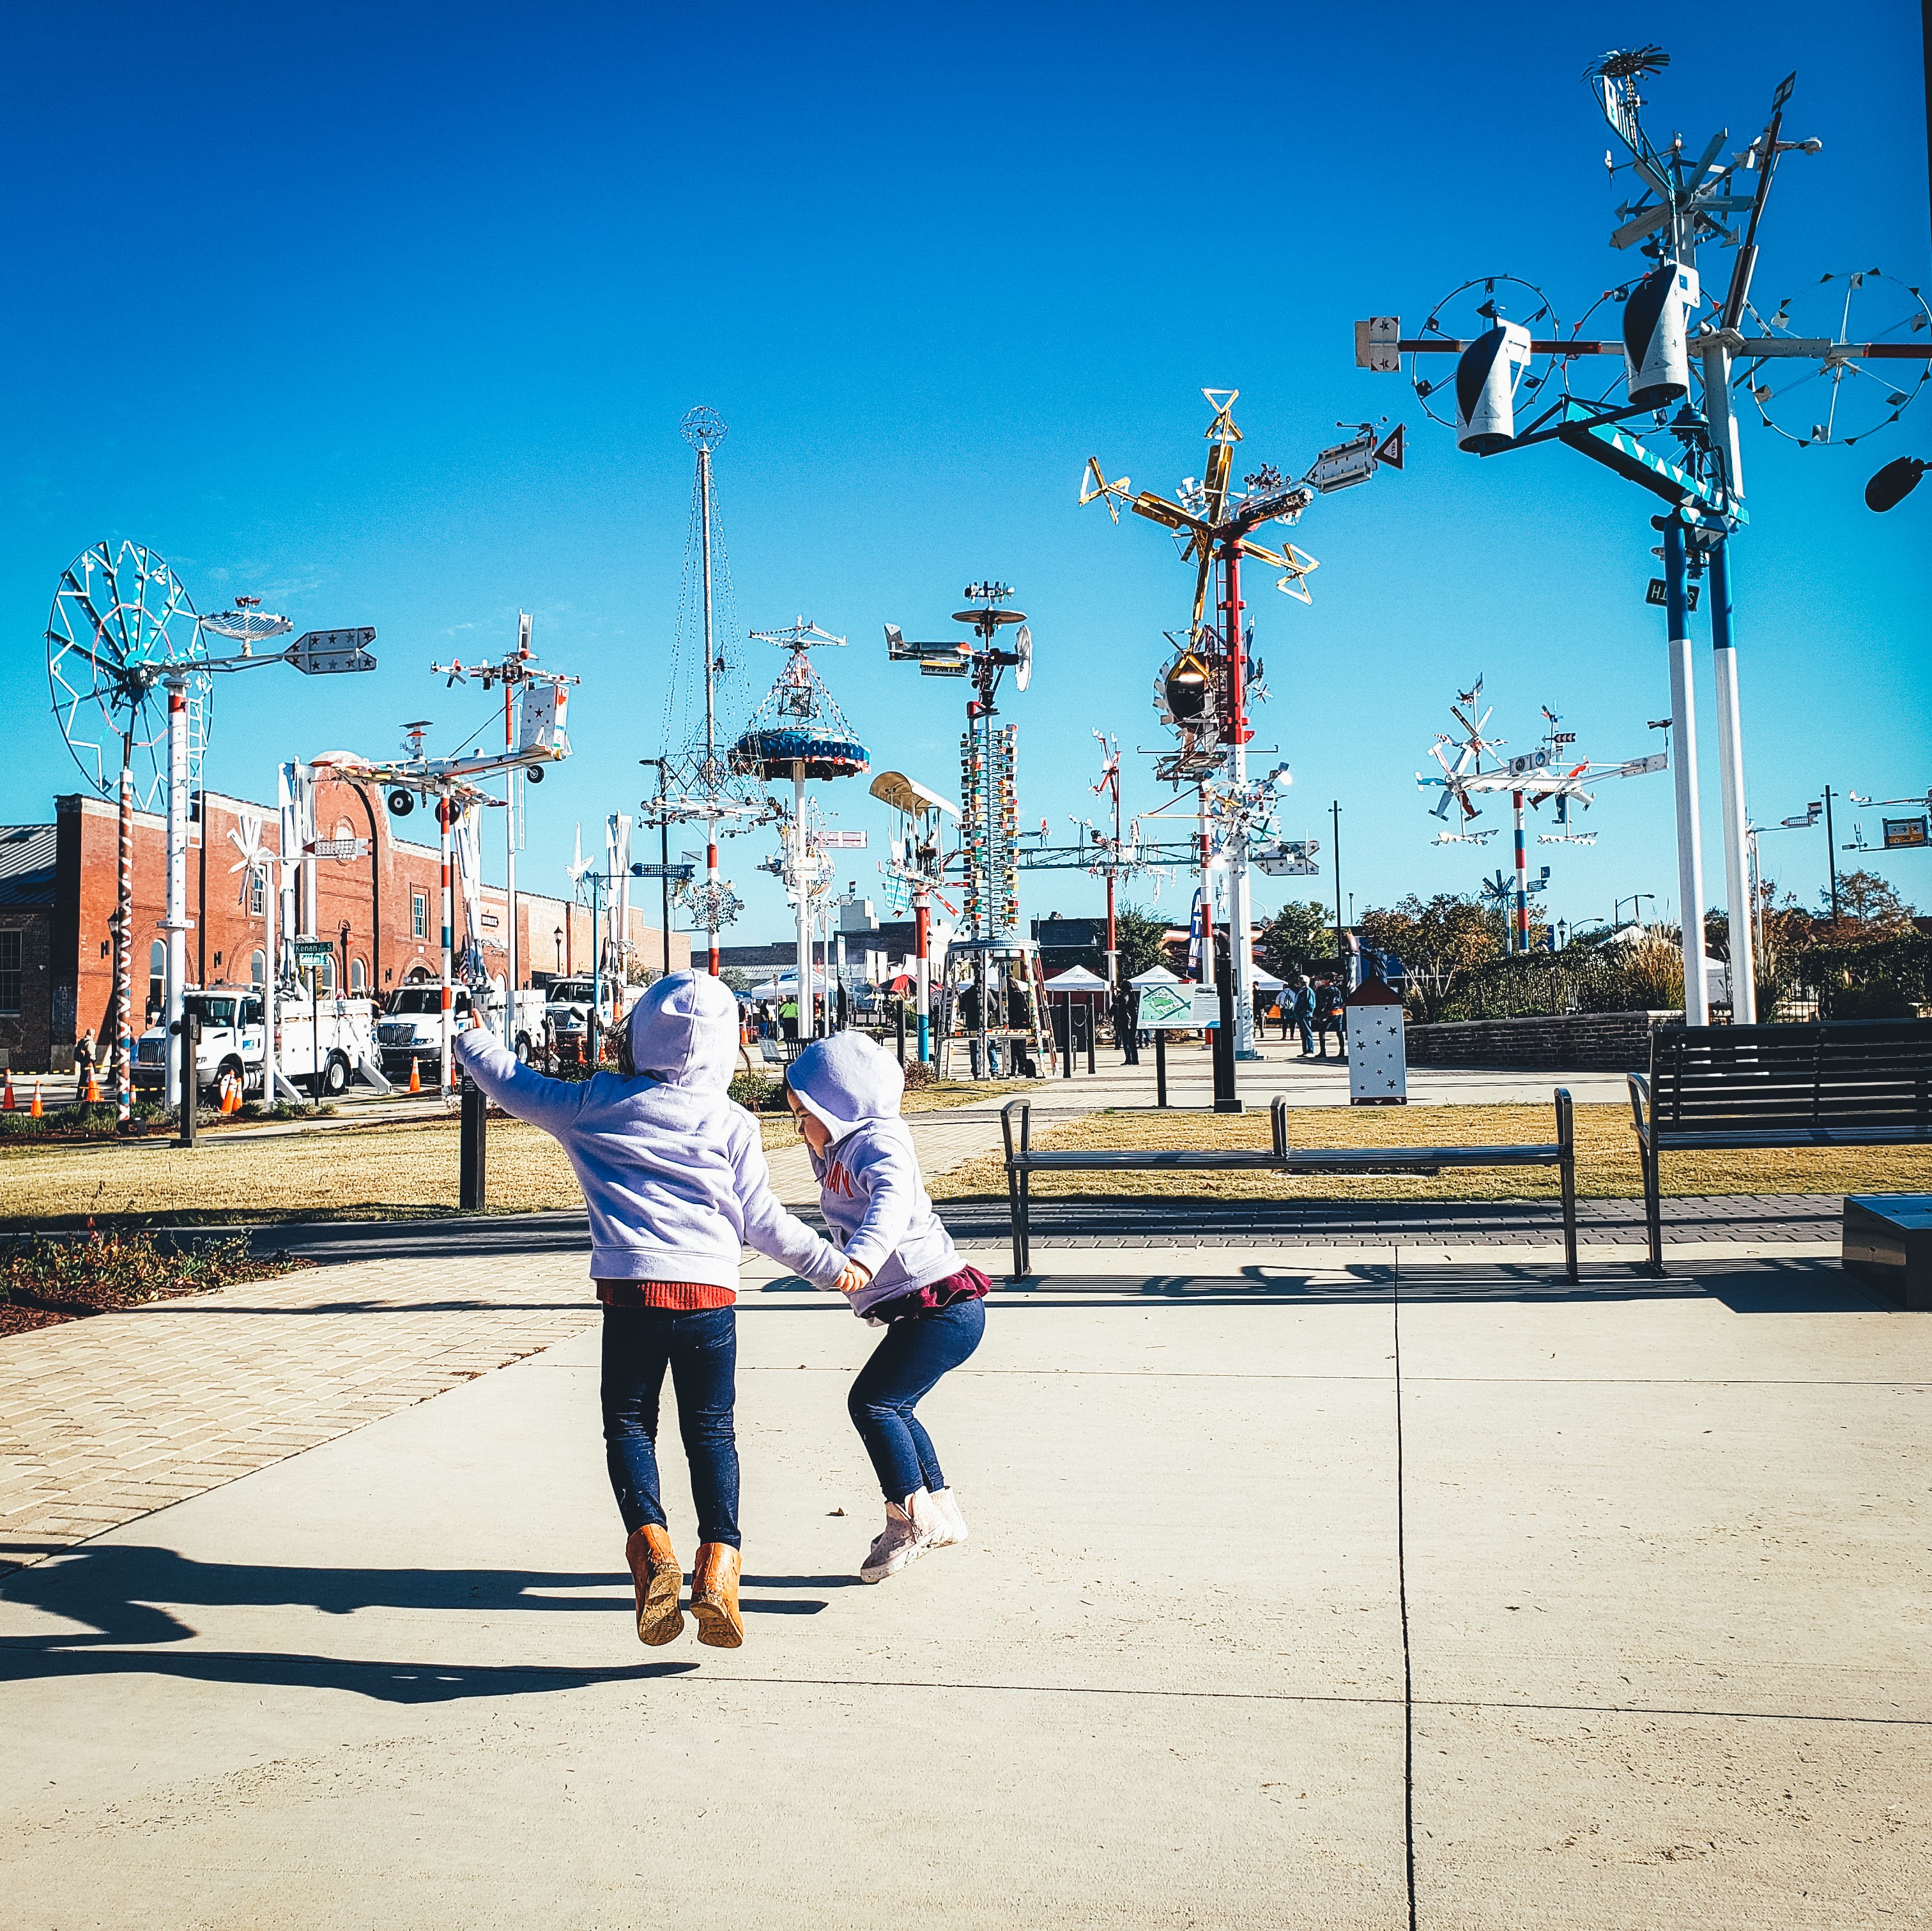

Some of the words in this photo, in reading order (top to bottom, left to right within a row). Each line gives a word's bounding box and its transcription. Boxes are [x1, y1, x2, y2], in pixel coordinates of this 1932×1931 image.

[1651, 584, 1695, 605] STH
[296, 944, 318, 952] Kenan
[327, 943, 332, 951] S
